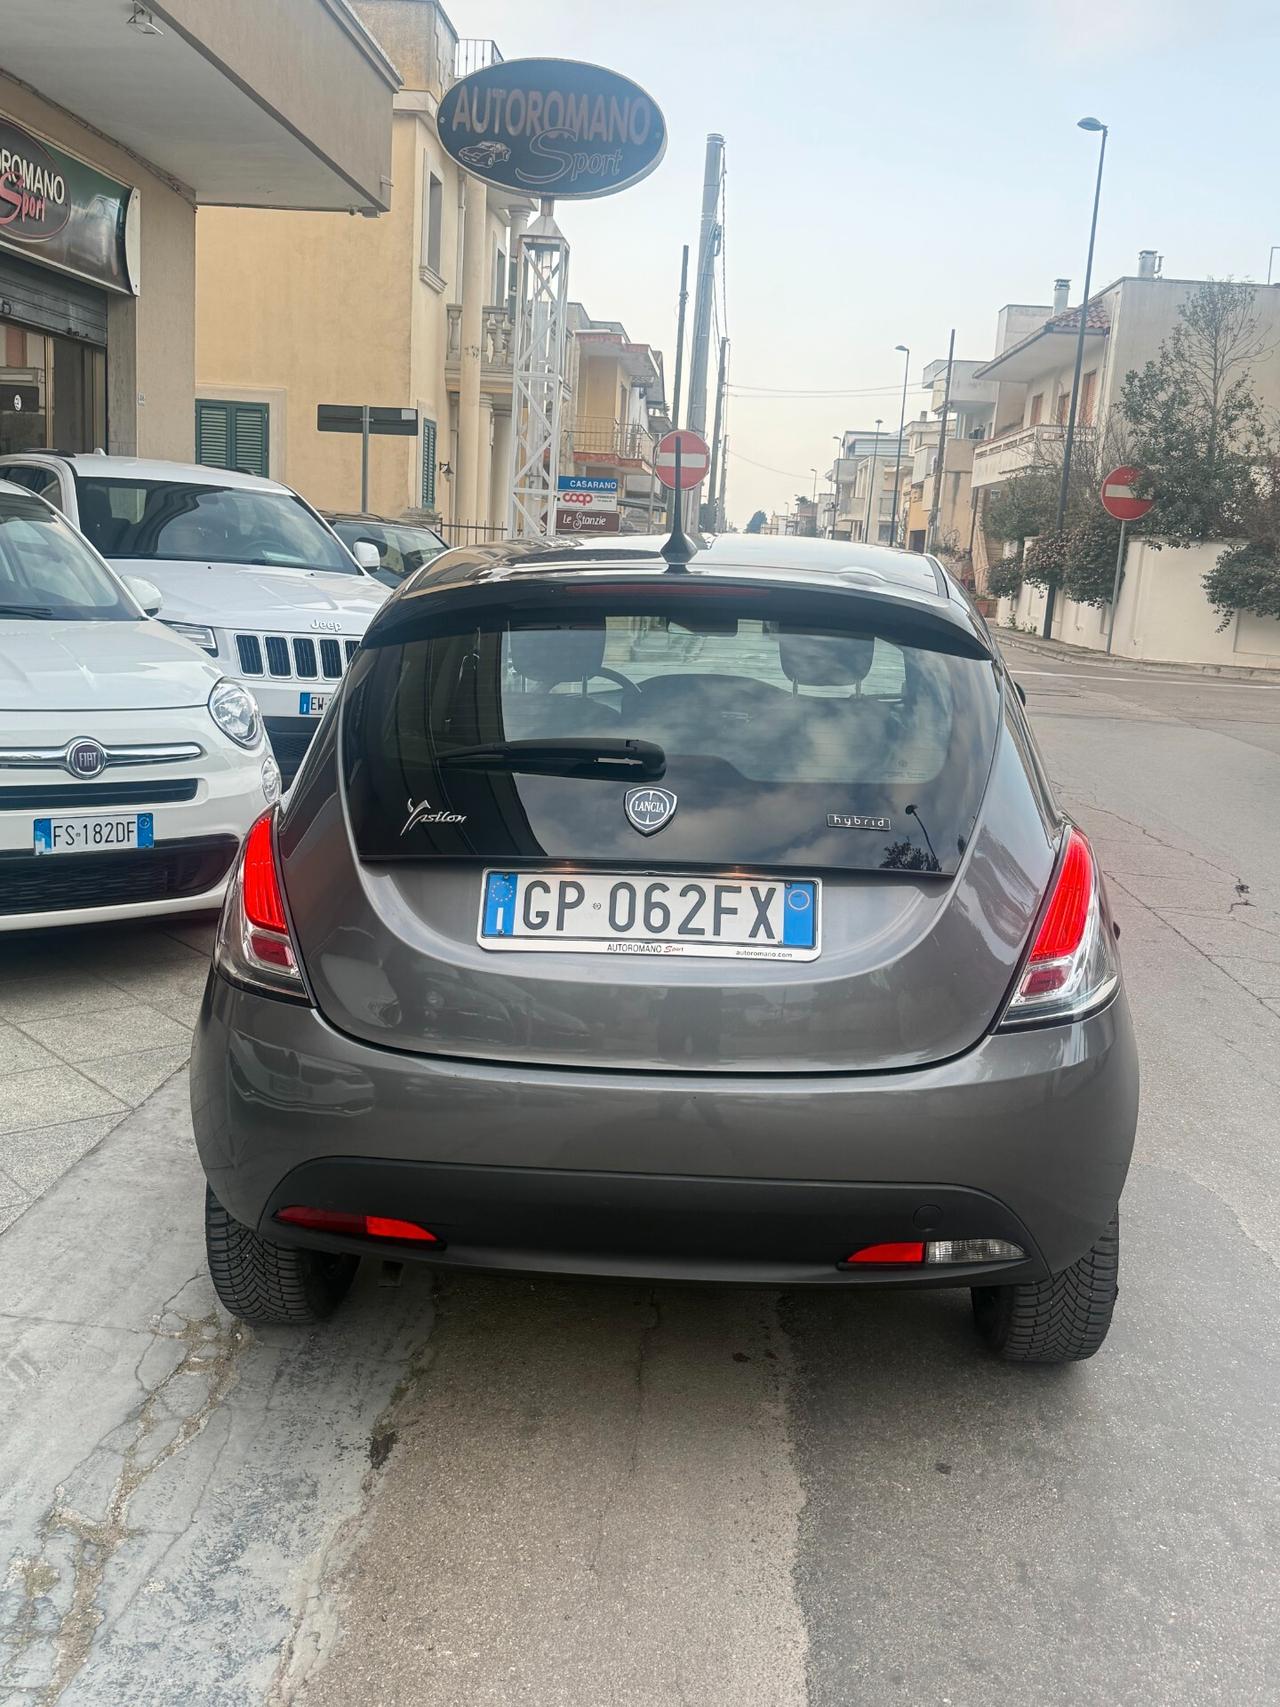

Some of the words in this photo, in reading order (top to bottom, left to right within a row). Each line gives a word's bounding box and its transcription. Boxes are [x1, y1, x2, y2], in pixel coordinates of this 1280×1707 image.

[452, 85, 650, 145] AUTOROMANO
[514, 127, 623, 184] Sport
[0, 148, 65, 205] ROMANO
[569, 480, 617, 489] CASARANO
[562, 492, 593, 506] coop
[562, 513, 572, 524] Le
[572, 511, 607, 530] Stanzie
[311, 619, 342, 632] Jeep
[79, 752, 97, 767] FIAT
[634, 800, 665, 813] LANCIA
[400, 798, 468, 836] Ypsilon
[833, 814, 885, 828] hybrid
[606, 943, 662, 953] AUTOROMANO
[664, 945, 684, 953] Sport
[735, 950, 793, 959] autoromano.com
